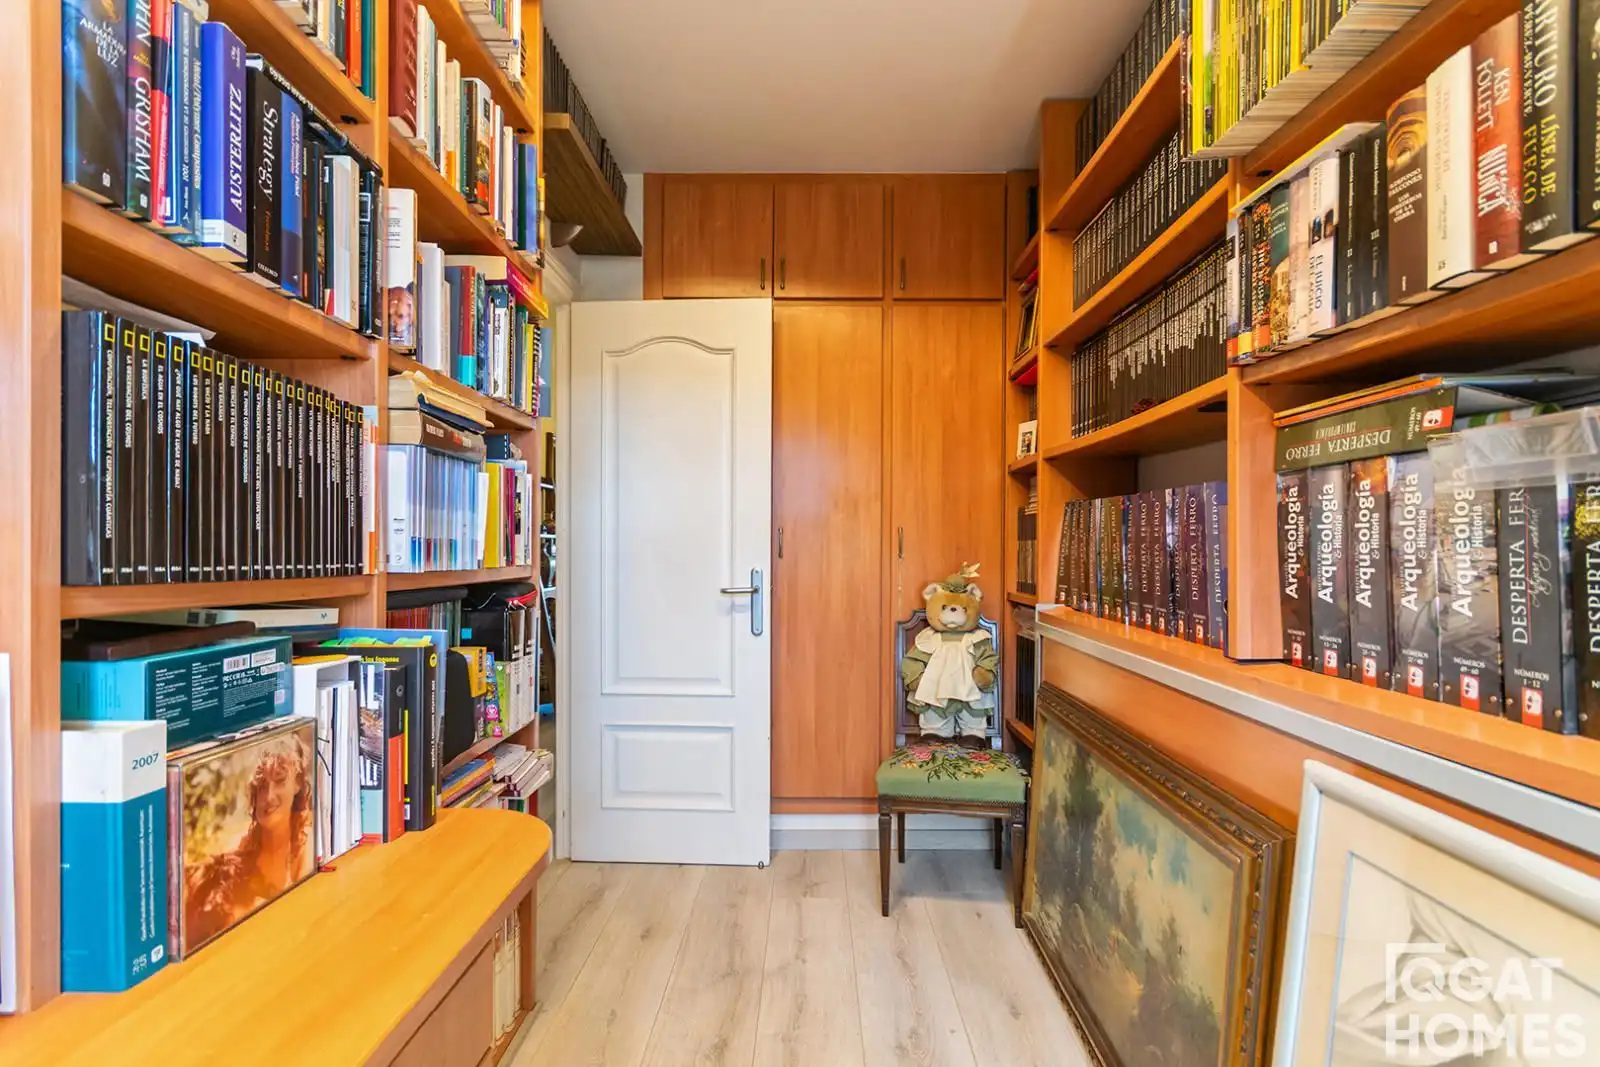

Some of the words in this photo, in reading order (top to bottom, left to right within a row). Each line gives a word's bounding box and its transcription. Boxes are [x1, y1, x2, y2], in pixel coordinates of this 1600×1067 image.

[1476, 58, 1494, 133] FOLLETT
[1492, 66, 1512, 107] KEN
[135, 77, 151, 182] GRISHAM
[229, 84, 242, 212] AUSTERLITZ
[259, 101, 279, 201] Strategy
[1540, 113, 1560, 171] LÍNEA
[182, 164, 190, 182] 1001
[192, 134, 202, 189] Composites
[1373, 139, 1381, 170] Cincuenta
[1522, 124, 1537, 205] FUEGO
[1477, 143, 1508, 217] NUNCA
[1540, 171, 1557, 197] DE
[1314, 254, 1324, 269] EL
[1314, 270, 1324, 310] JUICIO
[105, 350, 113, 396] COMPUTACIÓN,
[125, 356, 132, 364] LA
[141, 359, 148, 368] LA
[105, 398, 113, 448] TELEPORTACIÓN
[1327, 429, 1391, 453] DESPERTA
[1406, 406, 1416, 441] NÚMEROS
[1285, 441, 1321, 461] FERRO
[105, 455, 113, 502] CRIPTOGRAFÍA
[105, 502, 113, 538] CUÁNTICAS
[1472, 505, 1484, 548] Historia
[1508, 487, 1526, 526] FER
[1284, 486, 1301, 599] Arqueología
[1316, 481, 1338, 604] Arqueología
[1333, 513, 1343, 549] Historia
[1354, 478, 1376, 608] Arqueología
[1371, 512, 1381, 549] Historia
[1399, 472, 1422, 612] Arqueología
[1417, 509, 1428, 548] Historia
[1450, 467, 1477, 617] Arqueología
[1191, 543, 1199, 601] DESPERTA
[1509, 539, 1528, 645] DESPERTA
[1513, 668, 1550, 682] NÚMEROS
[131, 752, 160, 770] 2007
